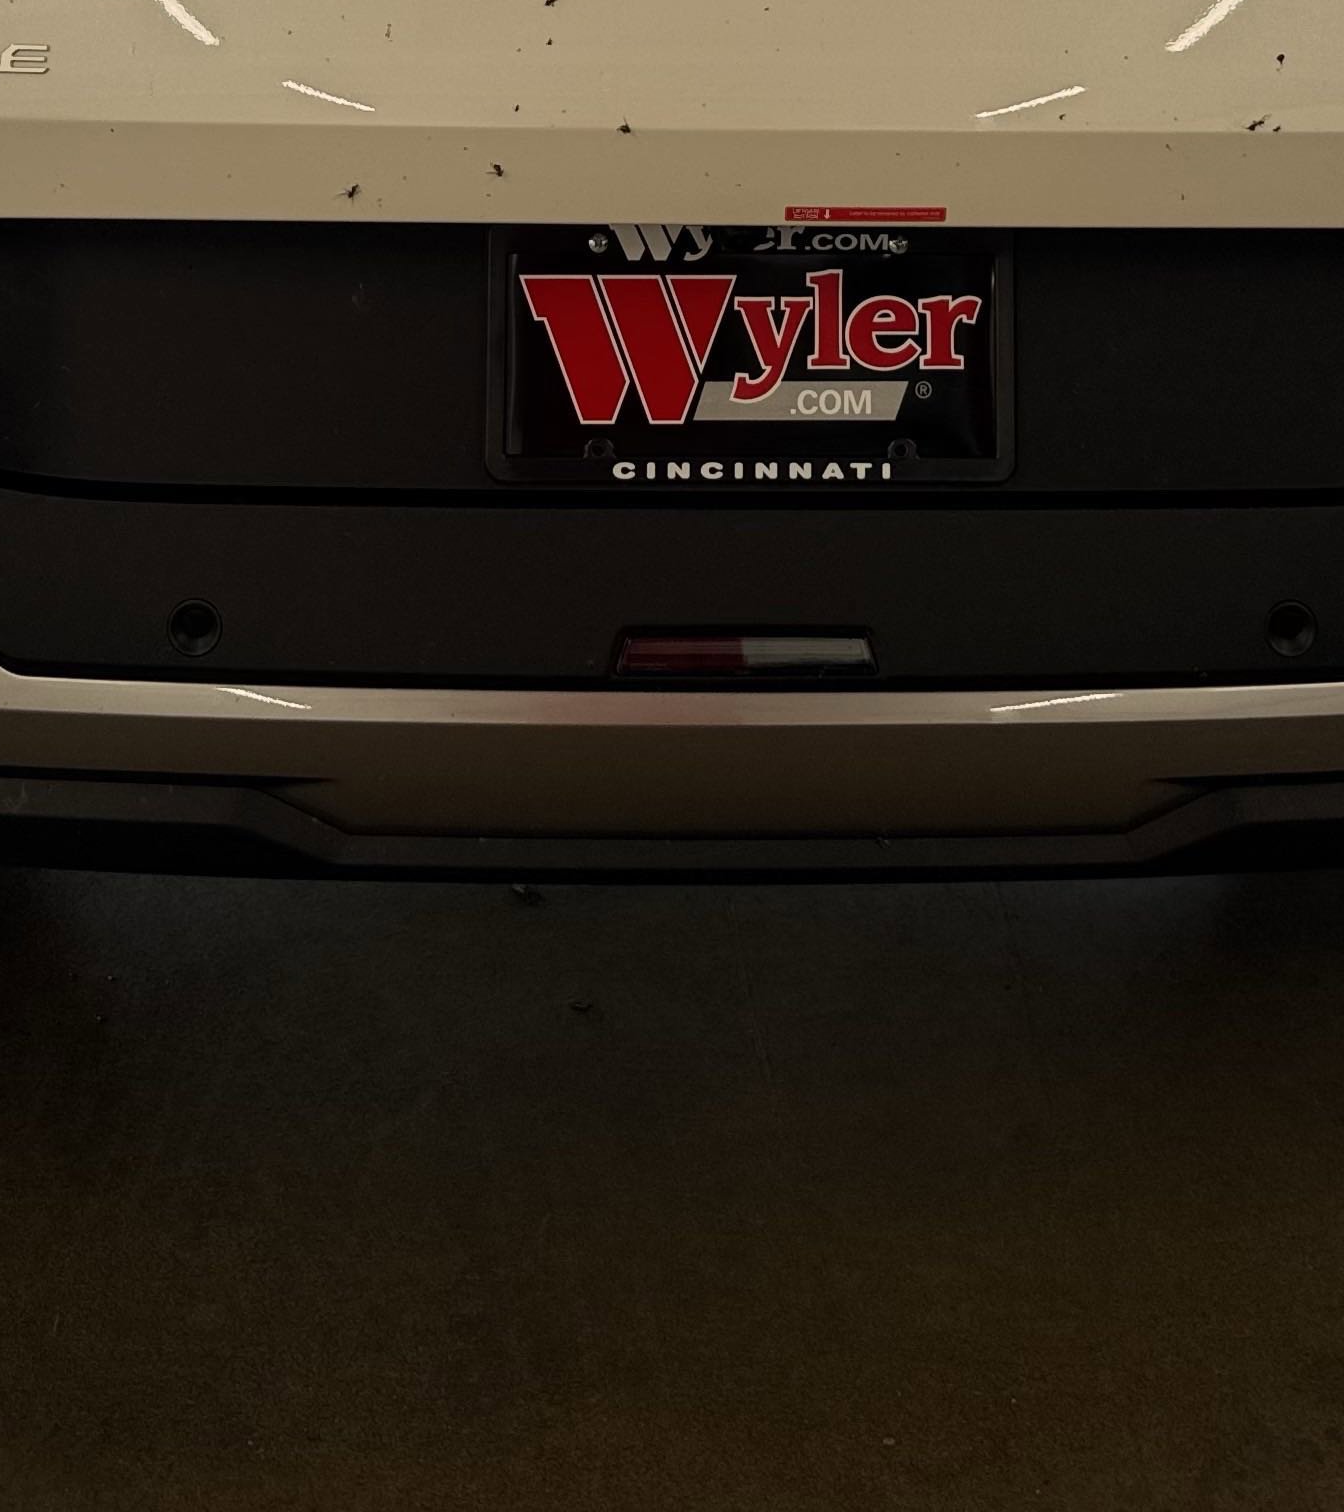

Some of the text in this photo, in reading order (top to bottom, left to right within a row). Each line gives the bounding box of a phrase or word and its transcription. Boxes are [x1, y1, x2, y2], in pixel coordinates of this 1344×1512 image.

[519, 269, 982, 424] Wyler
[790, 387, 872, 415] .COM
[612, 461, 893, 480] CINCINNATI
